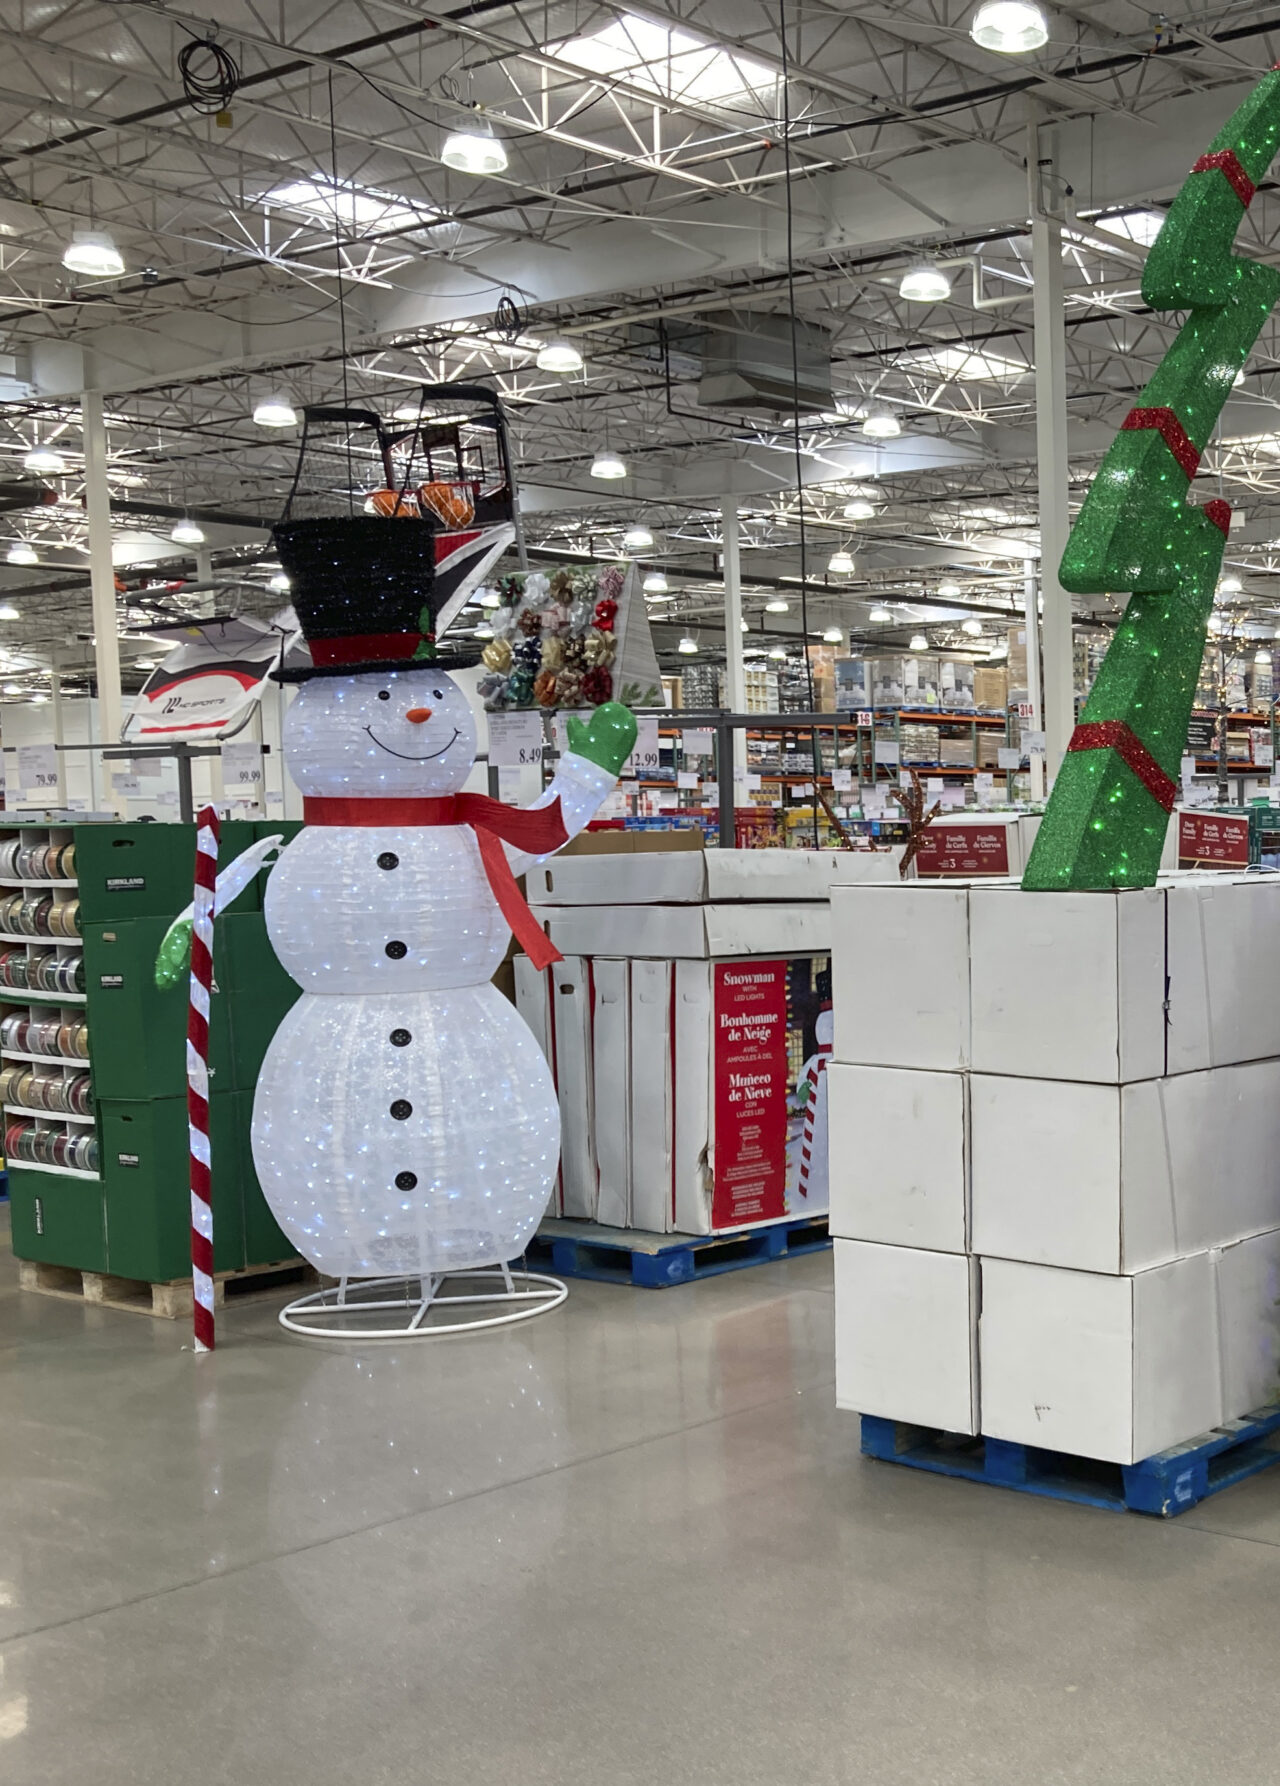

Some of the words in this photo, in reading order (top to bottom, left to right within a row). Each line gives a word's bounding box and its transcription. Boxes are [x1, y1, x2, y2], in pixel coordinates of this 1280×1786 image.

[1019, 704, 1034, 716] 314
[519, 748, 542, 764] 8.49
[629, 753, 658, 767] 12.99
[36, 773, 58, 786] 79.99
[239, 770, 261, 782] 99.99
[950, 858, 956, 869] 3
[107, 878, 144, 886] KIRKLAND
[723, 971, 775, 986] Snowman
[734, 994, 746, 1002] LED
[720, 1012, 778, 1028] Bonhomme
[728, 1029, 741, 1042] de
[743, 1026, 771, 1045] Neige
[743, 1046, 758, 1054] AVEC
[727, 1054, 757, 1063] AMPOULES
[728, 1073, 772, 1088] Muñeco
[728, 1089, 742, 1102] de
[744, 1086, 772, 1101] Nieve
[745, 1101, 757, 1109] CON
[736, 1109, 754, 1119] LUCES
[755, 1108, 765, 1116] LED
